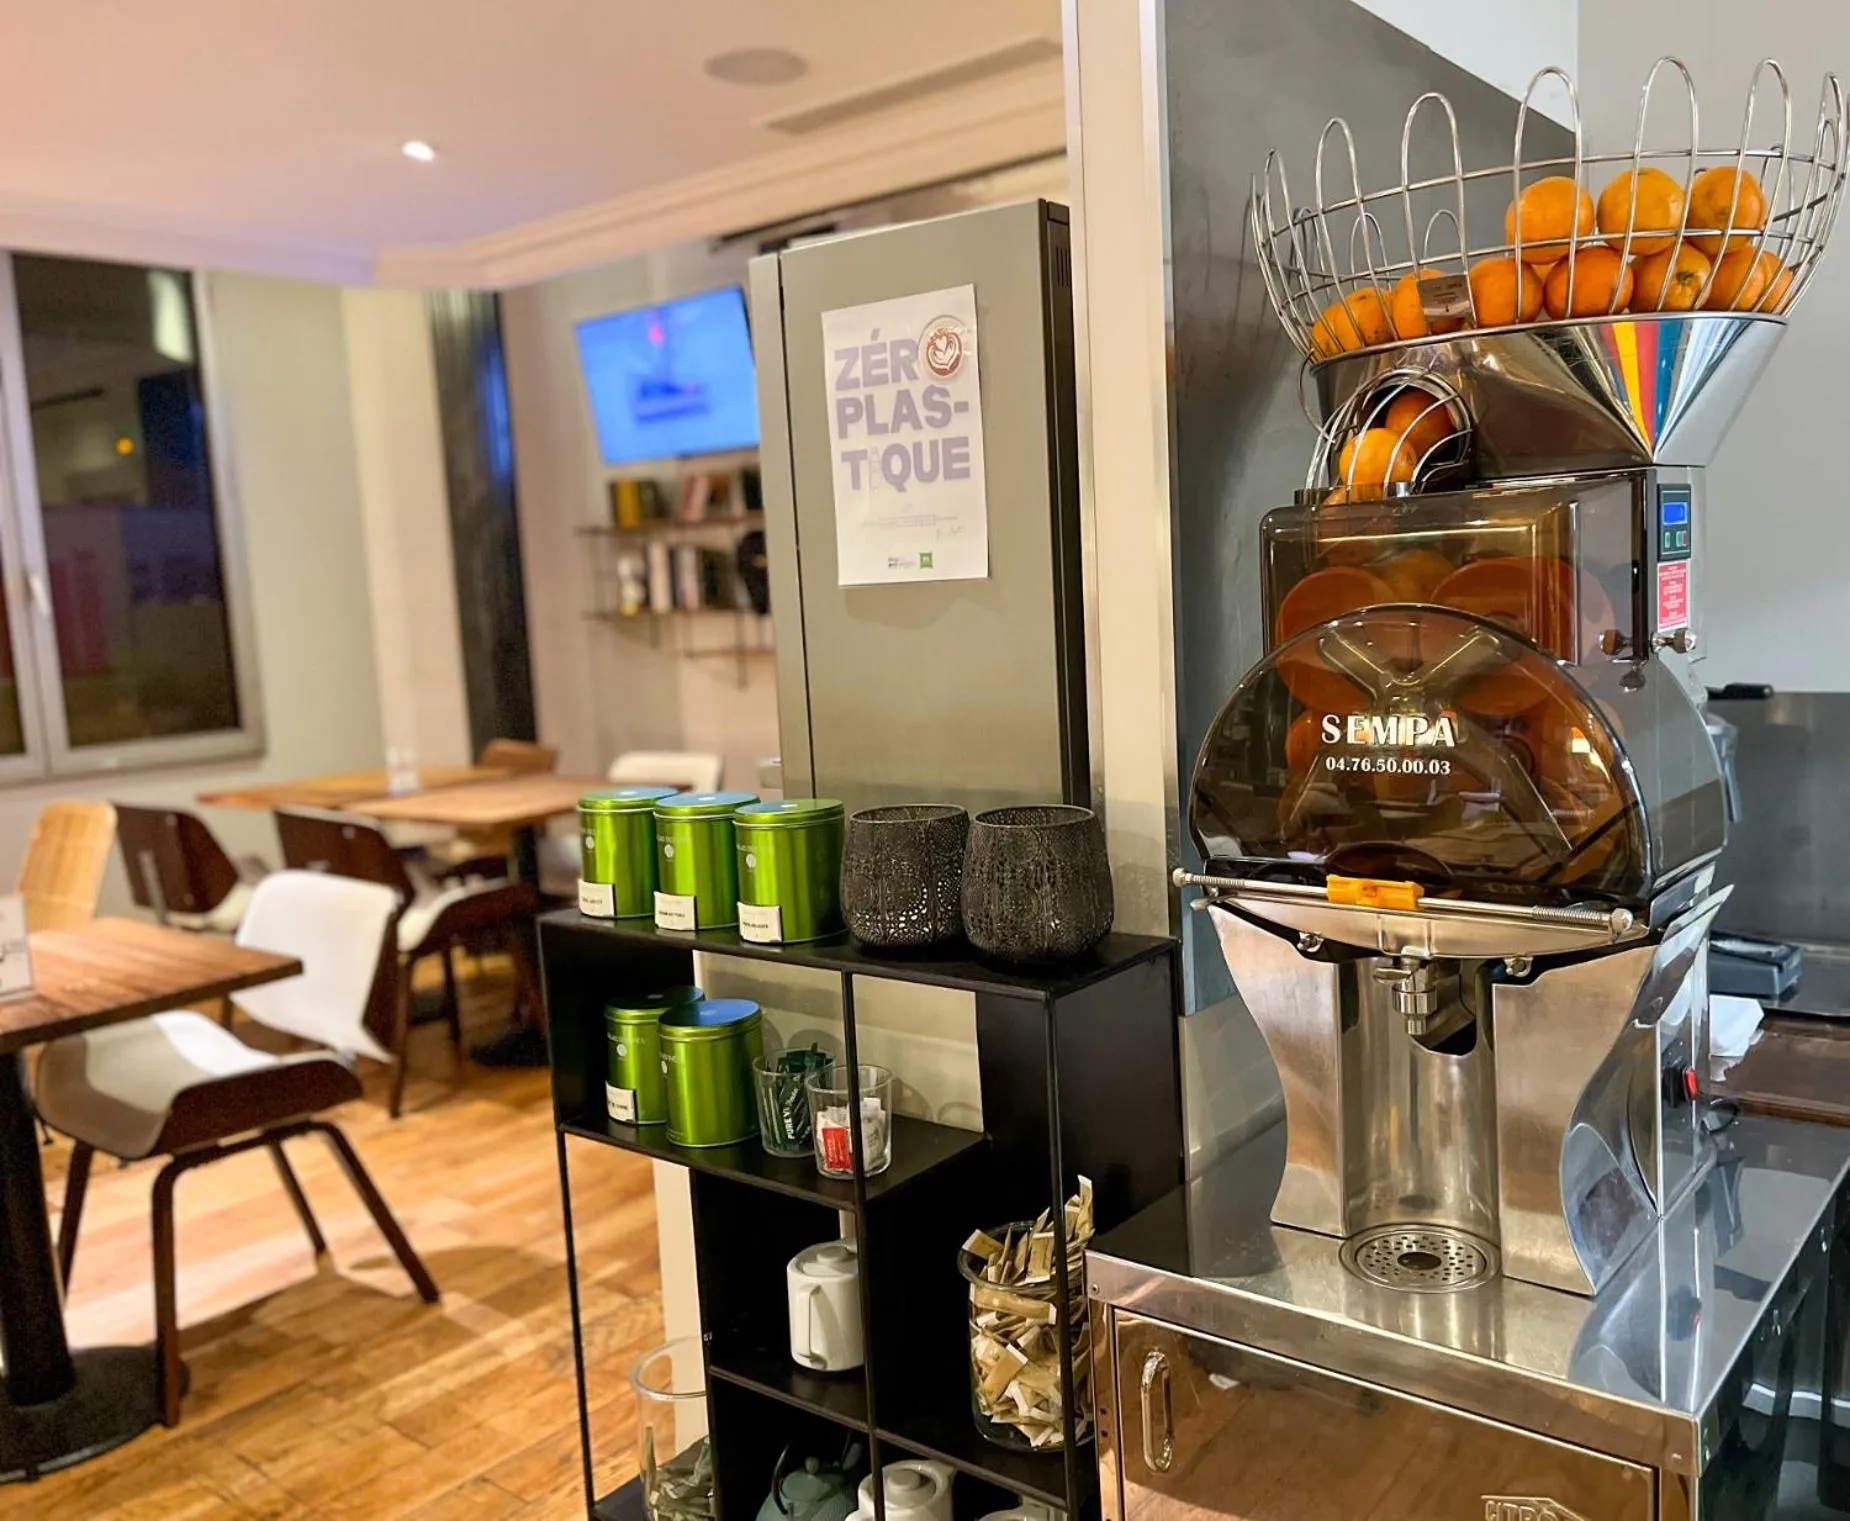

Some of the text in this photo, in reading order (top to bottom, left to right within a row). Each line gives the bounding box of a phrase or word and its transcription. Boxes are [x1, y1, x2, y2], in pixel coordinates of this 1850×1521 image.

[836, 385, 969, 439] PLAS-
[841, 436, 971, 493] TQUE
[1321, 714, 1456, 747] SEMPA
[1325, 756, 1451, 775] 04.76.50.00.03
